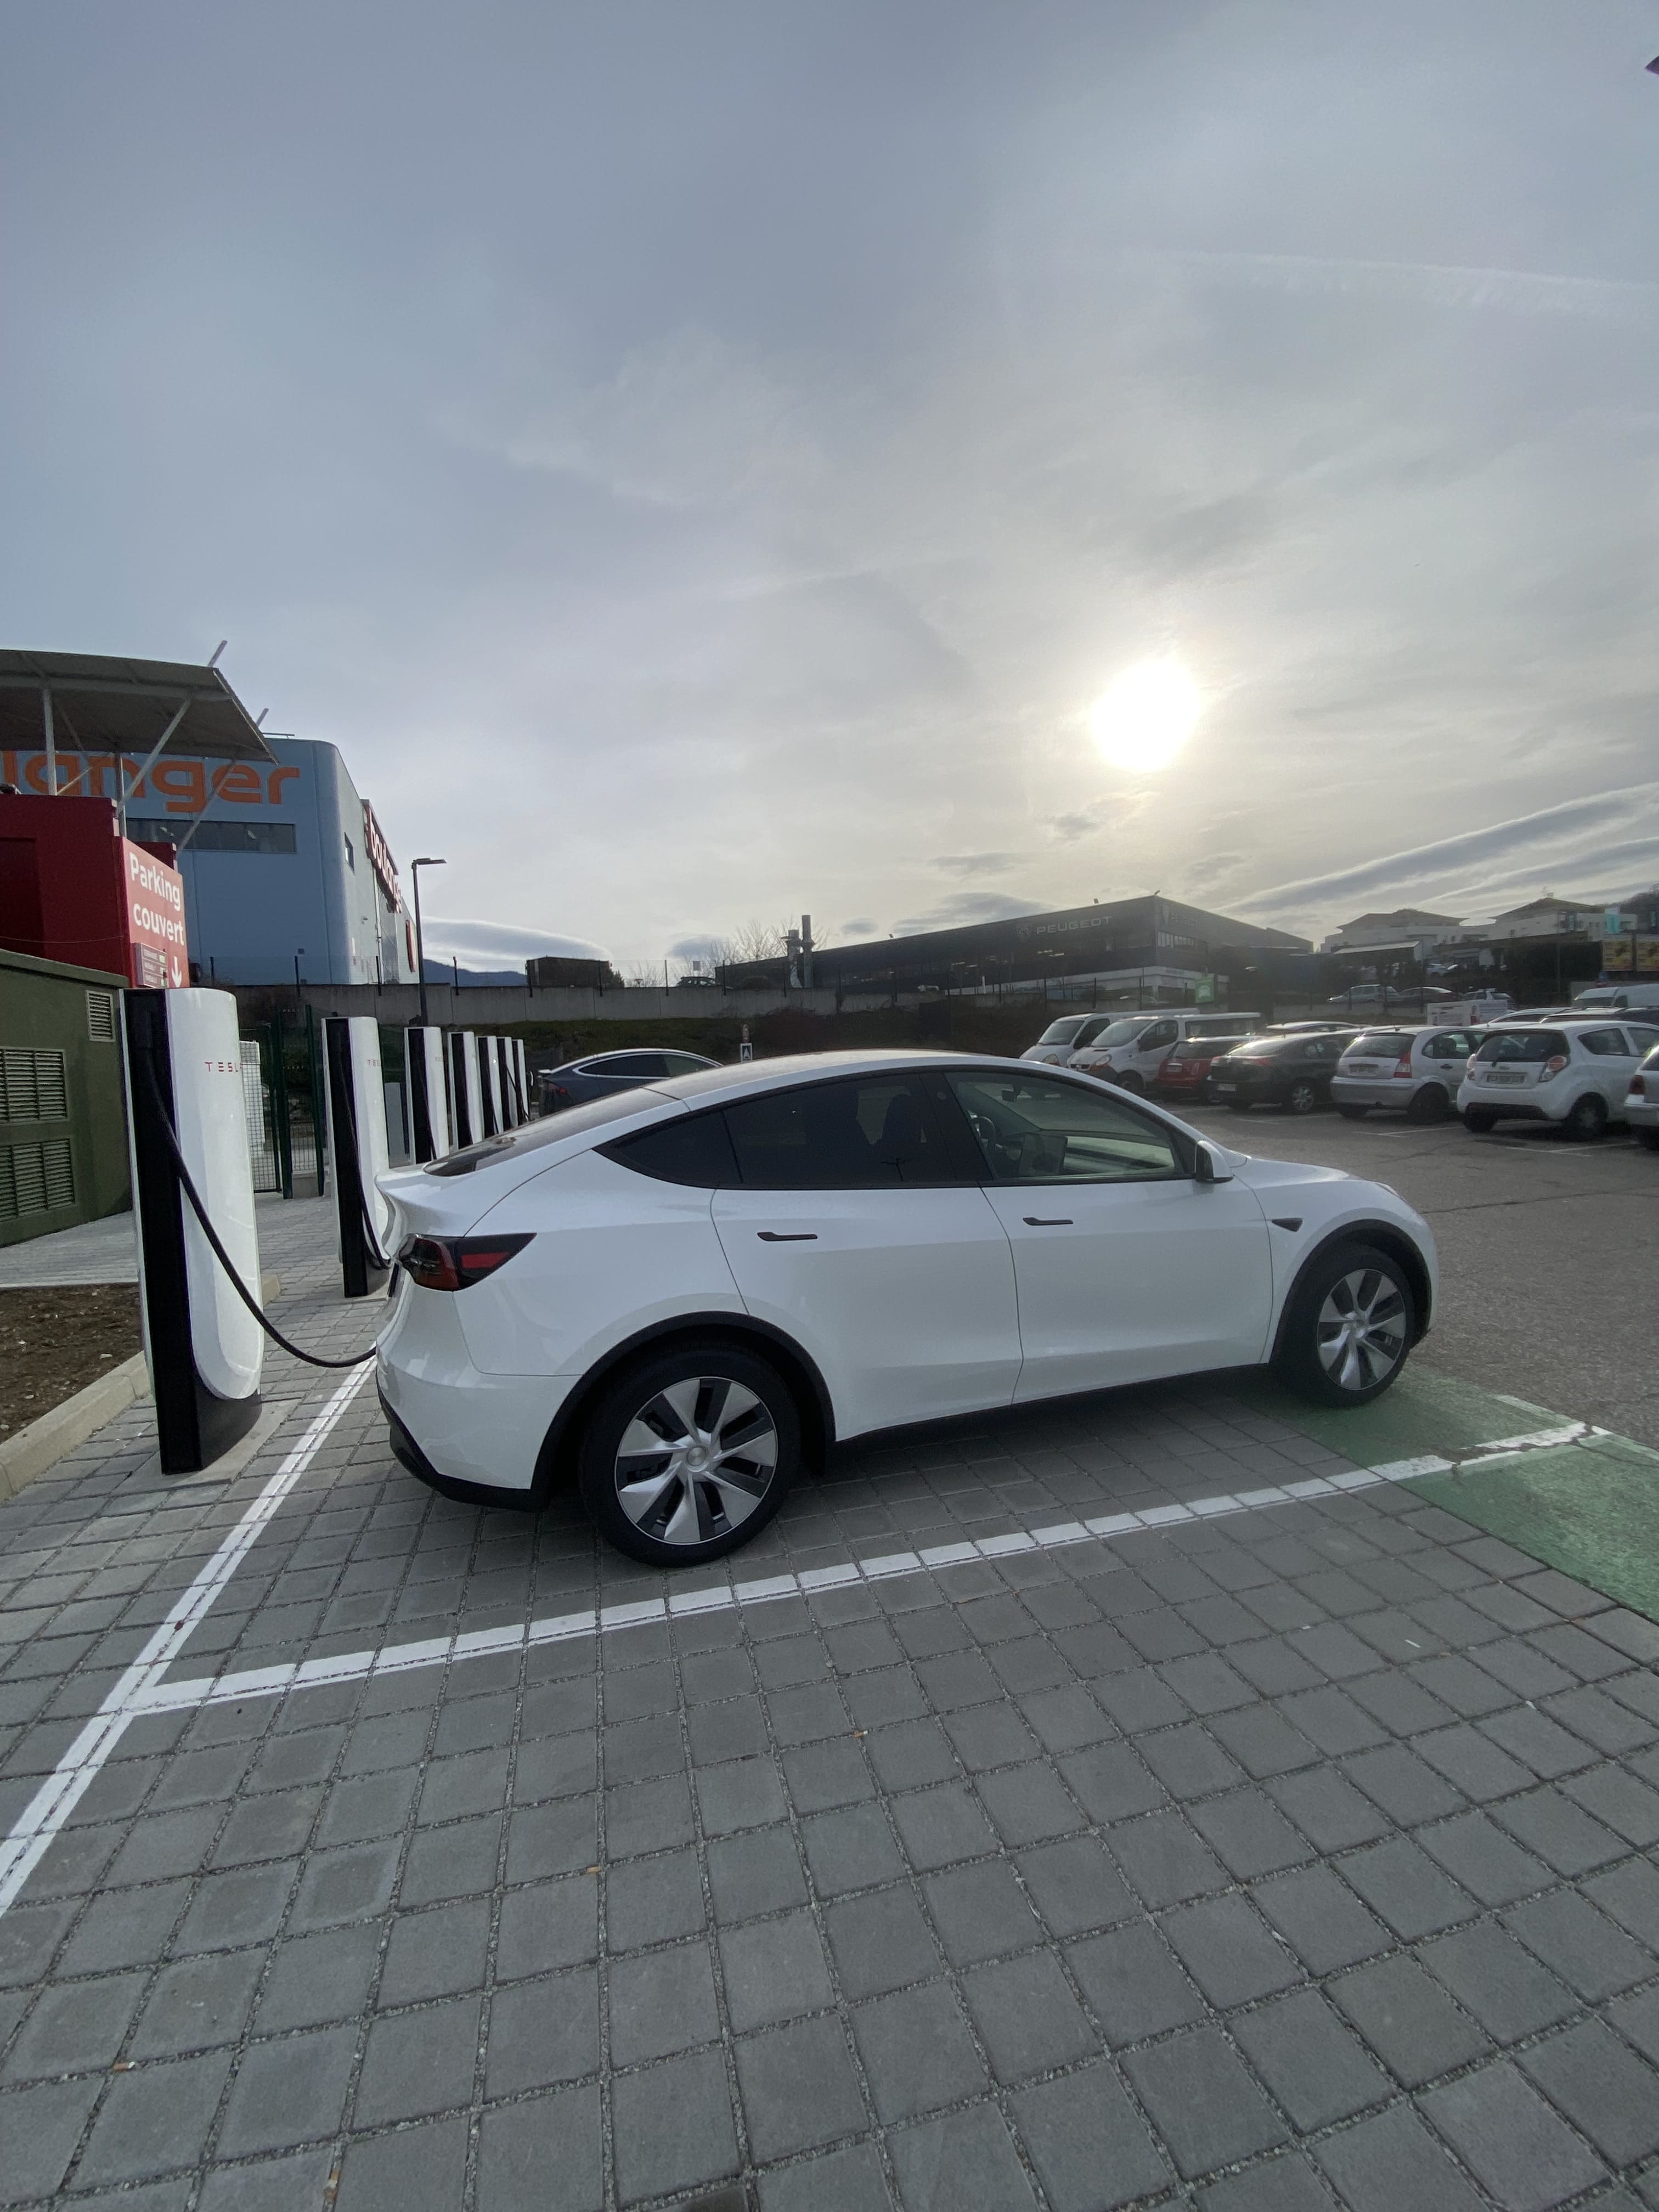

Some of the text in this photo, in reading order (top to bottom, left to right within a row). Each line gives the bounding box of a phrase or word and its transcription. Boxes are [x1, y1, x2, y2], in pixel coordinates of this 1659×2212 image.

[129, 851, 181, 912] Parking
[133, 903, 184, 946] couvert
[1036, 916, 1113, 935] PEUGEOT
